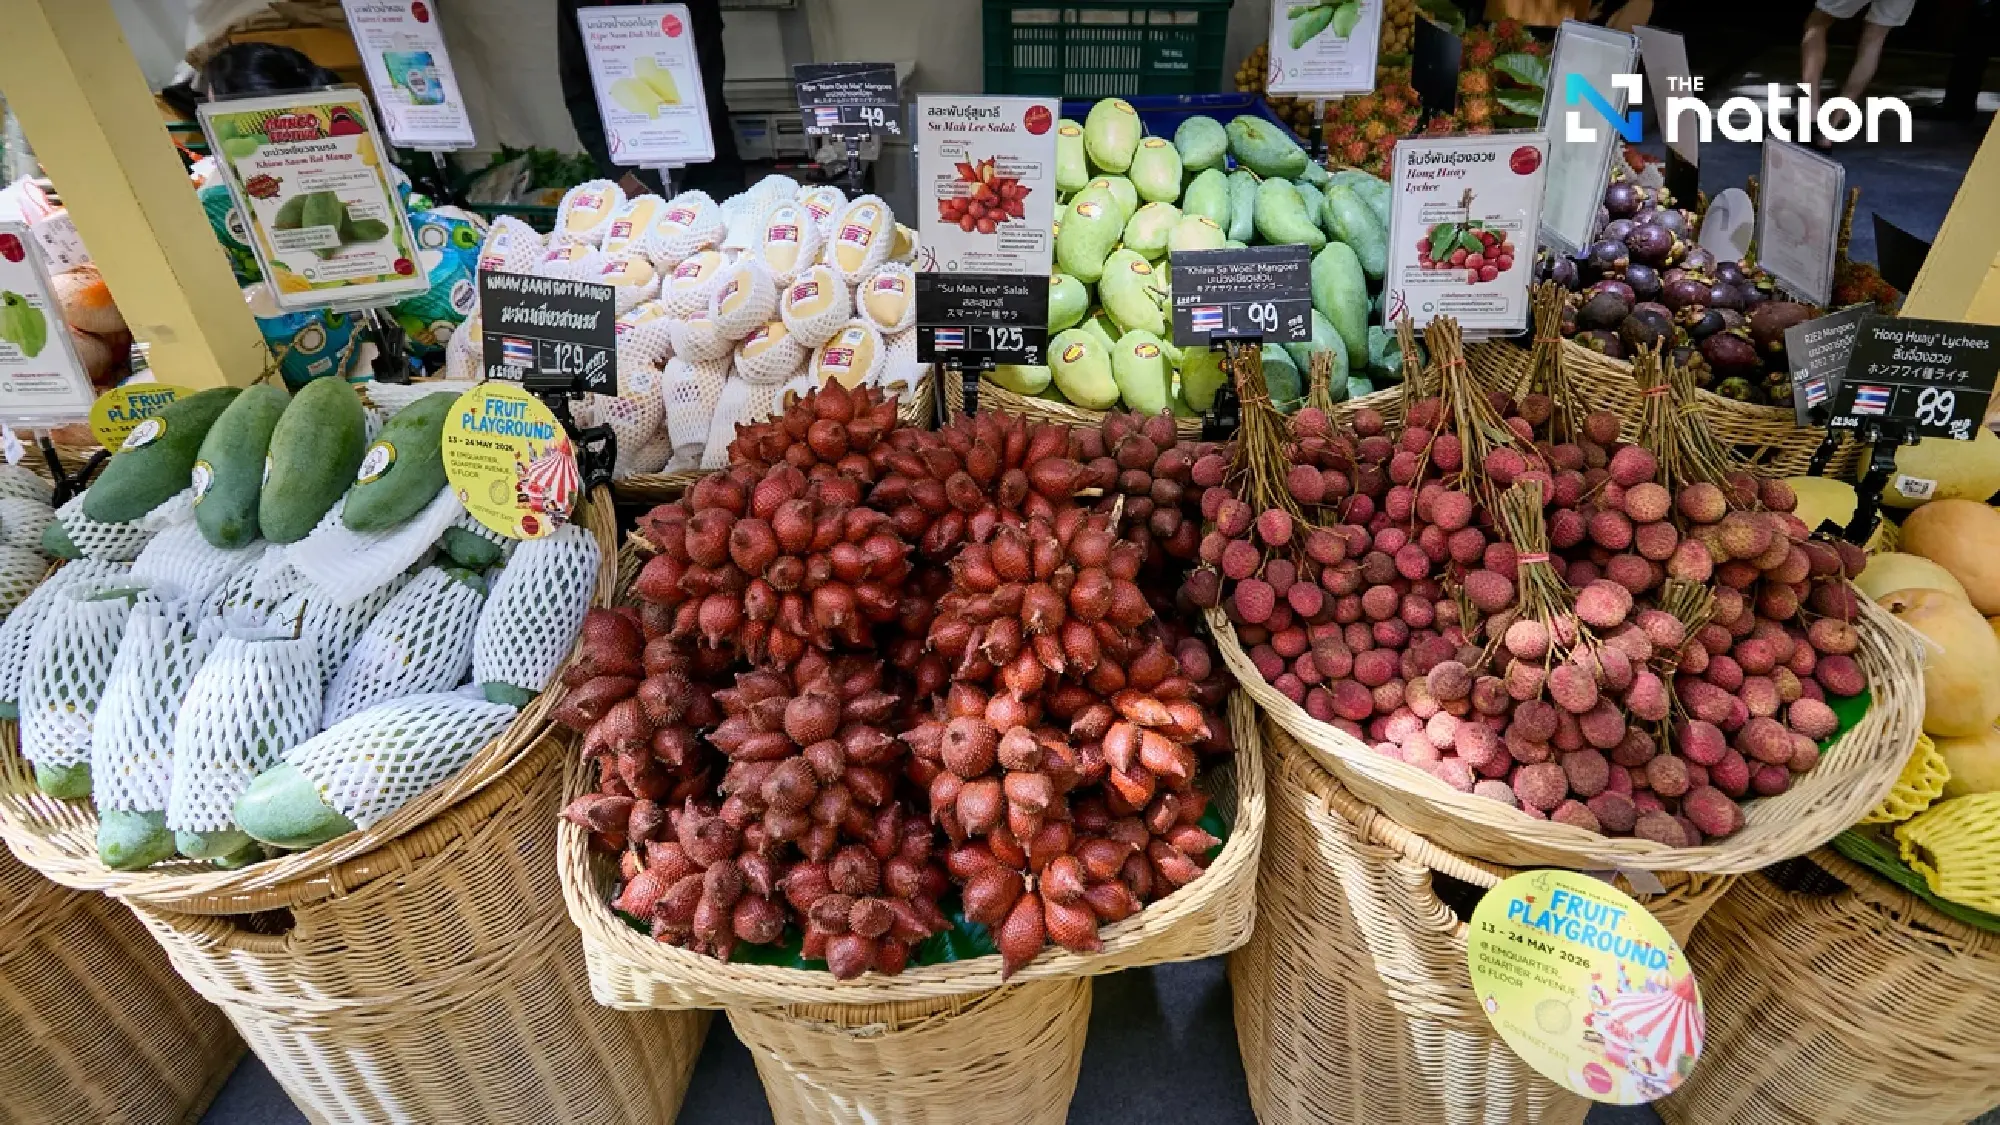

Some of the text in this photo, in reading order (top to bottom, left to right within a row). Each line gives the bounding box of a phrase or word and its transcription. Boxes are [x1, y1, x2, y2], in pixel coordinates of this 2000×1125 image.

[860, 106, 884, 127] 49
[927, 122, 1018, 132] Su Mah Lee Salak
[1406, 168, 1466, 180] Hong Huay
[1405, 182, 1440, 194] Lychee
[1217, 265, 1229, 274] Sa
[1258, 262, 1299, 273] Mangoes
[957, 284, 977, 293] Mah
[1003, 285, 1029, 295] Salak
[1248, 302, 1279, 333] 99
[986, 326, 1024, 351] 125
[1872, 328, 1989, 349] "Hong Huay" Lychees
[553, 342, 585, 374] 129
[128, 391, 175, 407] FRUIT
[485, 398, 529, 419] FRUIT
[1915, 386, 1956, 426] 89
[462, 413, 555, 440] PLAYGROUND
[476, 440, 492, 448] MAY
[495, 442, 514, 451] 2026
[451, 459, 483, 469] QUARTIER
[458, 468, 479, 478] FLOOR
[1549, 889, 1627, 932] FRUIT
[1506, 898, 1668, 970] PLAYGROUND
[1481, 921, 1496, 934] 13
[1508, 931, 1524, 944] 24
[1527, 937, 1556, 955] MAY
[1560, 950, 1591, 969] 2026
[1477, 964, 1524, 988] G FLOOR
[1479, 953, 1531, 979] QUARTIER
